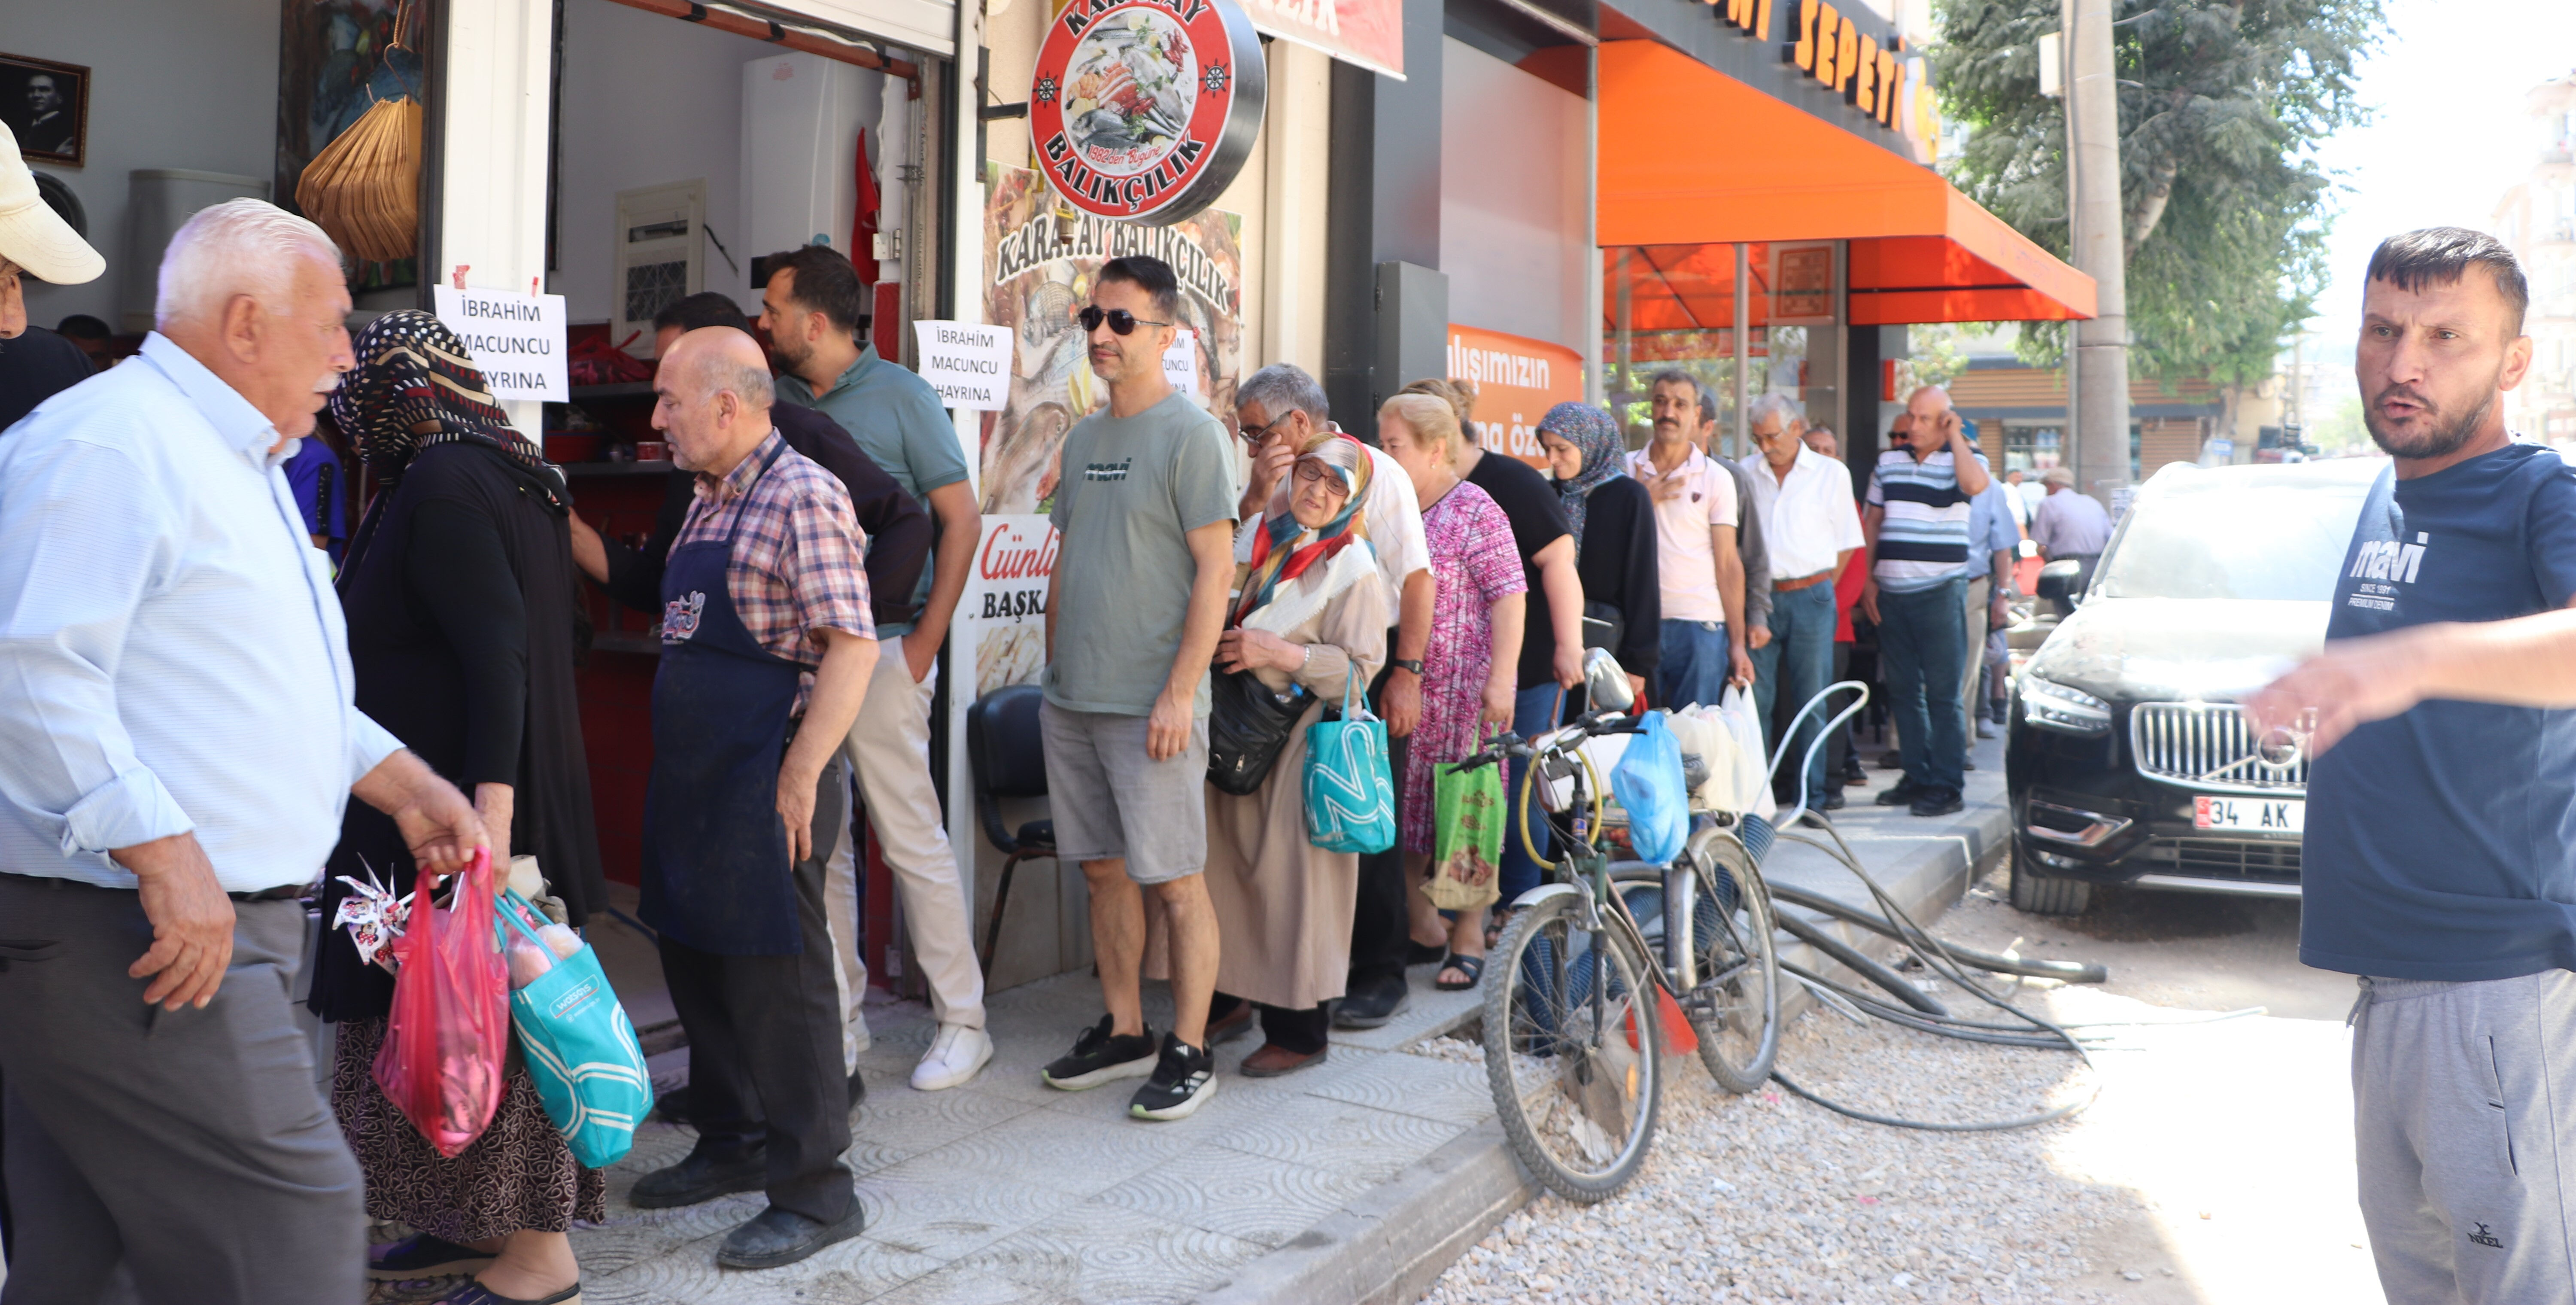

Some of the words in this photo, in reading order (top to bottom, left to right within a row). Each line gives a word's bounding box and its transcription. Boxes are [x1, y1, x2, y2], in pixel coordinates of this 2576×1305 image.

[1045, 129, 1206, 212] BALIKÇILIK
[462, 295, 541, 321] İBRAHİM
[456, 333, 550, 355] MACUNCU
[936, 326, 993, 348] İBRAHİM
[932, 355, 998, 374] MACUNCU
[480, 371, 547, 389] AYRINA
[936, 384, 991, 402] HAYRINA
[1083, 457, 1132, 481] mavi
[2349, 531, 2429, 583] mavi
[2360, 583, 2376, 593] SINCE
[2377, 584, 2391, 595] 1991
[982, 590, 1045, 623] BAŞK
[2211, 801, 2238, 825] 34
[2261, 802, 2289, 828] AK
